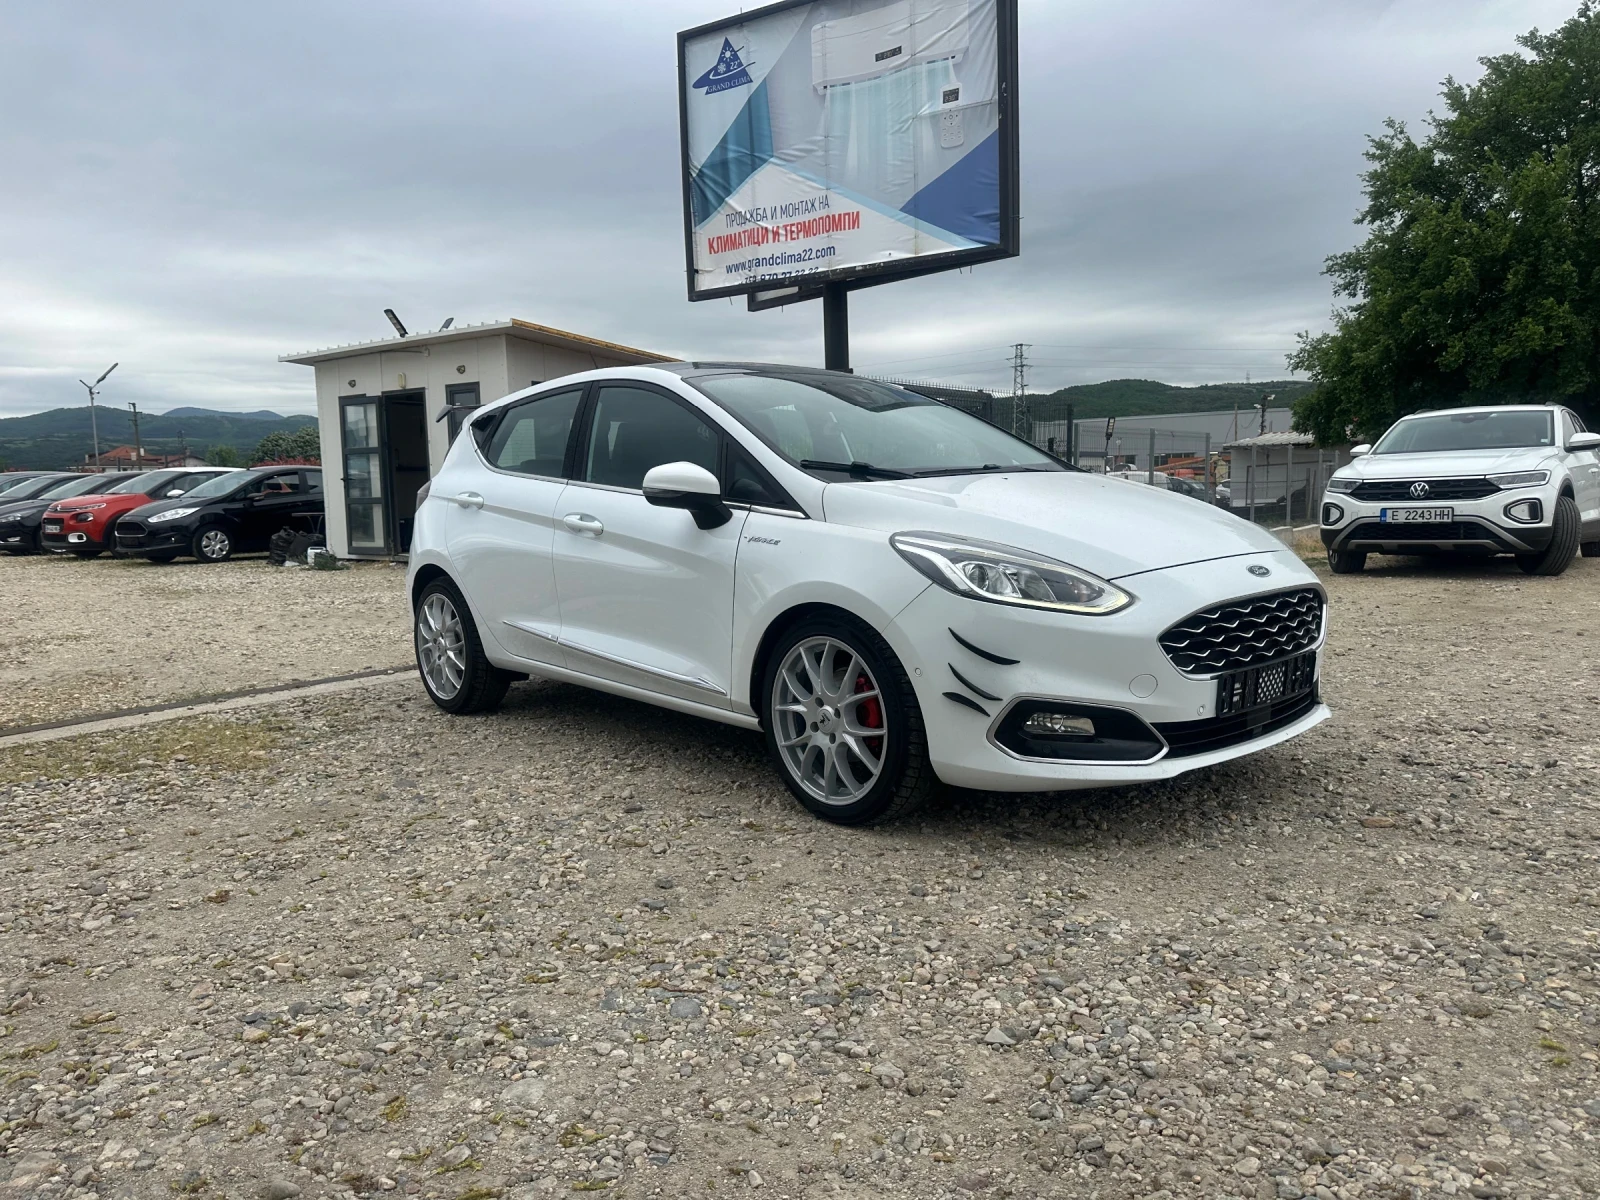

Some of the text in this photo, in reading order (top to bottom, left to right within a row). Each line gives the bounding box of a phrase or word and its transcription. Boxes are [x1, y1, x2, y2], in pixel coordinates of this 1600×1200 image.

[707, 76, 751, 92] GRAND CLIMA
[726, 194, 830, 228] ПРОДАЖБА И МОНТАЖ НА
[708, 210, 860, 255] КЛИМАТИЦИ И ТЕРМОПОМПИ
[725, 245, 836, 275] www.grandclima22.com
[1391, 511, 1399, 521] E
[1404, 510, 1432, 521] 2243
[1434, 509, 1450, 520] HH
